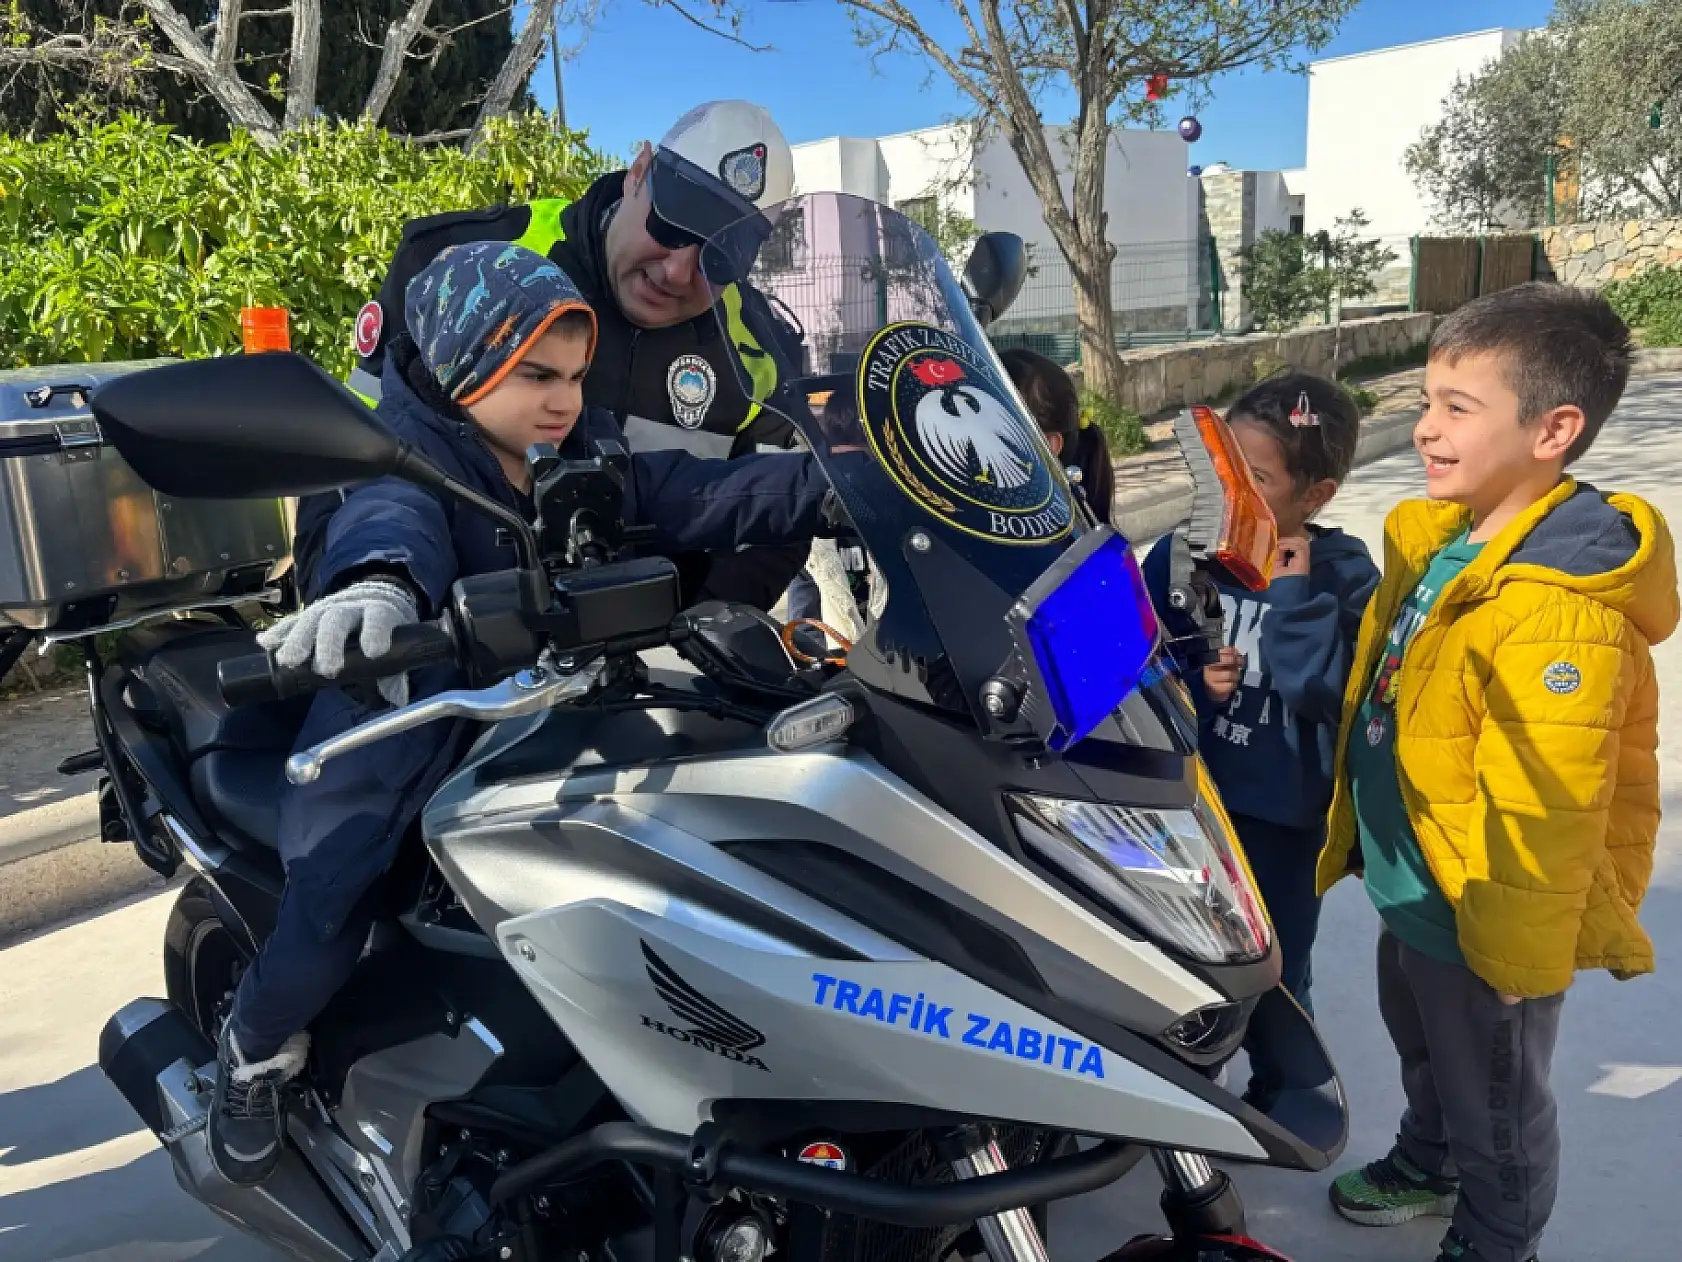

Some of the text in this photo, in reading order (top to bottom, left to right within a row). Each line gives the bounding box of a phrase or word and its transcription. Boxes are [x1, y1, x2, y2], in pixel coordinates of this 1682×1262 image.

[639, 1014, 771, 1073] HONDA
[812, 972, 1105, 1079] TRAFİK ZABITA
